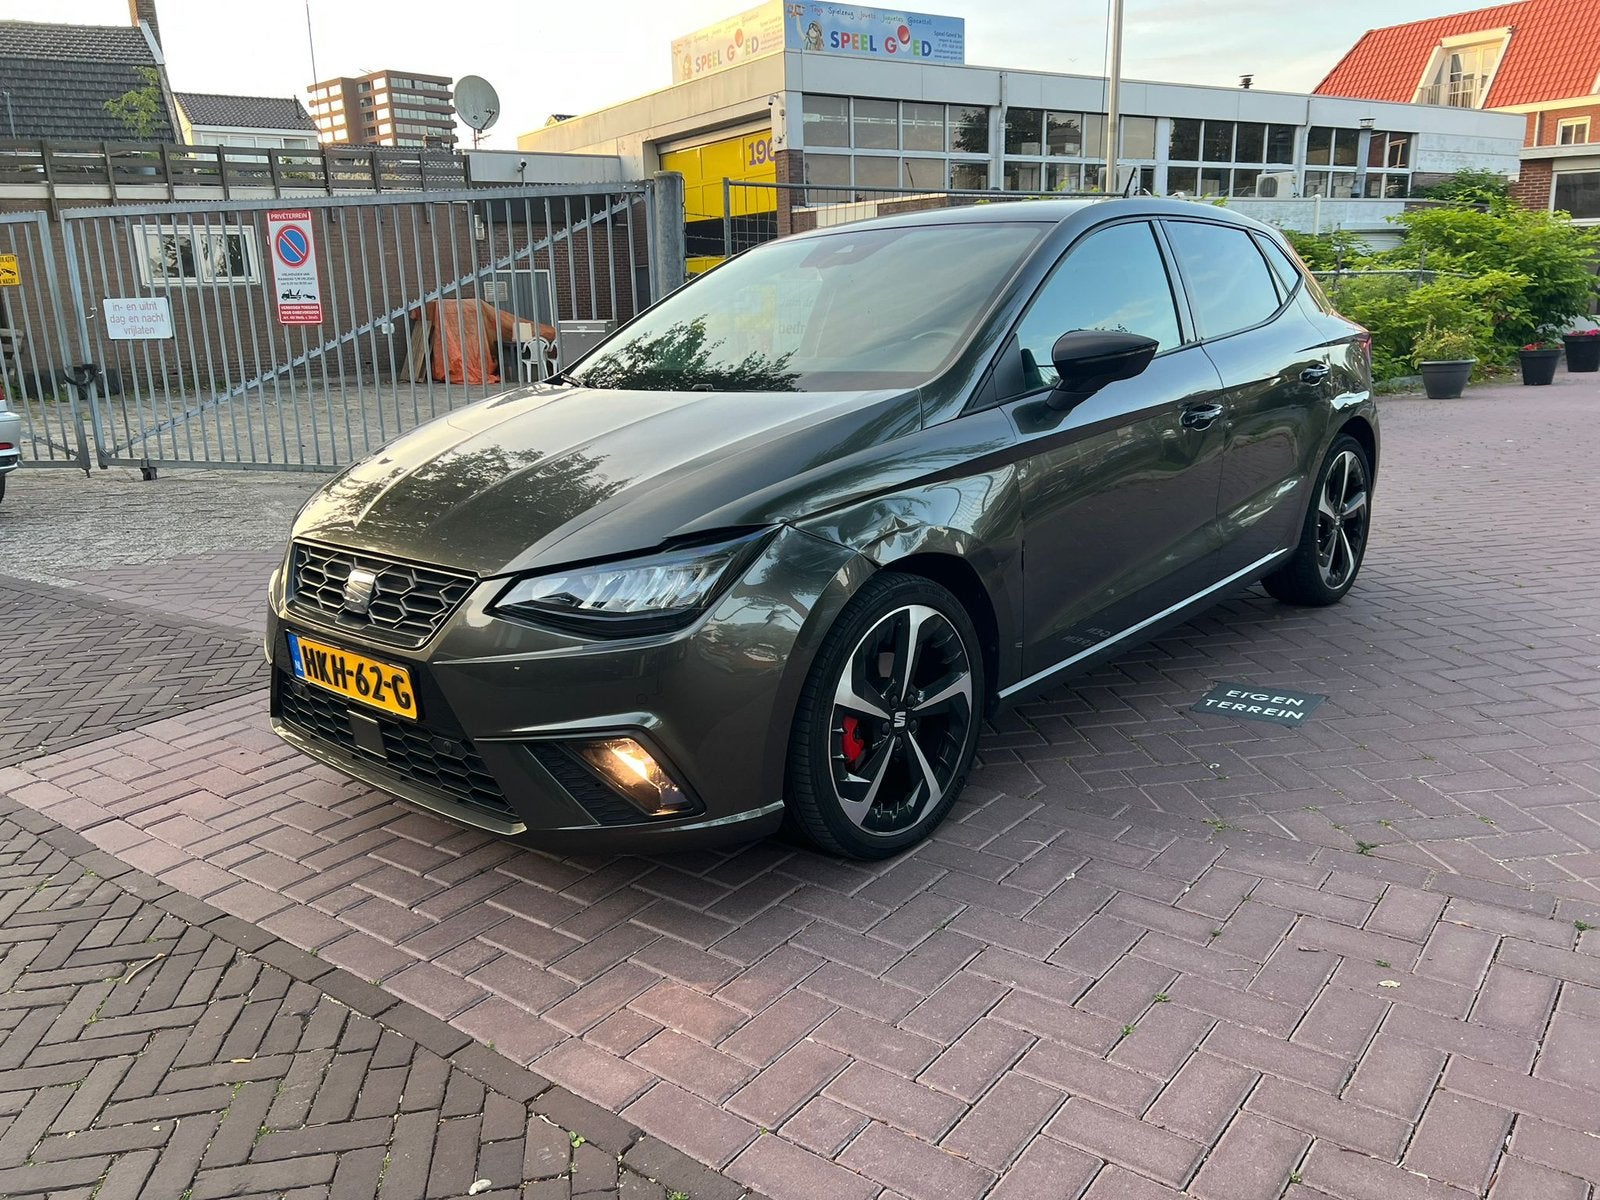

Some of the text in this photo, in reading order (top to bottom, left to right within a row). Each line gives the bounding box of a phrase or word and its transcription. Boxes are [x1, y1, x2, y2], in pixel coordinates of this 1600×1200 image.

[695, 49, 722, 73] SPEEL
[726, 28, 759, 61] GOED
[830, 25, 932, 57] SPEEL GOED
[126, 303, 137, 311] en
[110, 313, 165, 325] dag en nacht
[124, 325, 156, 336] vrijlaten
[301, 645, 411, 710] HKH-62-G
[1226, 689, 1304, 707] EIGEN
[1205, 699, 1304, 720] TERREIN
